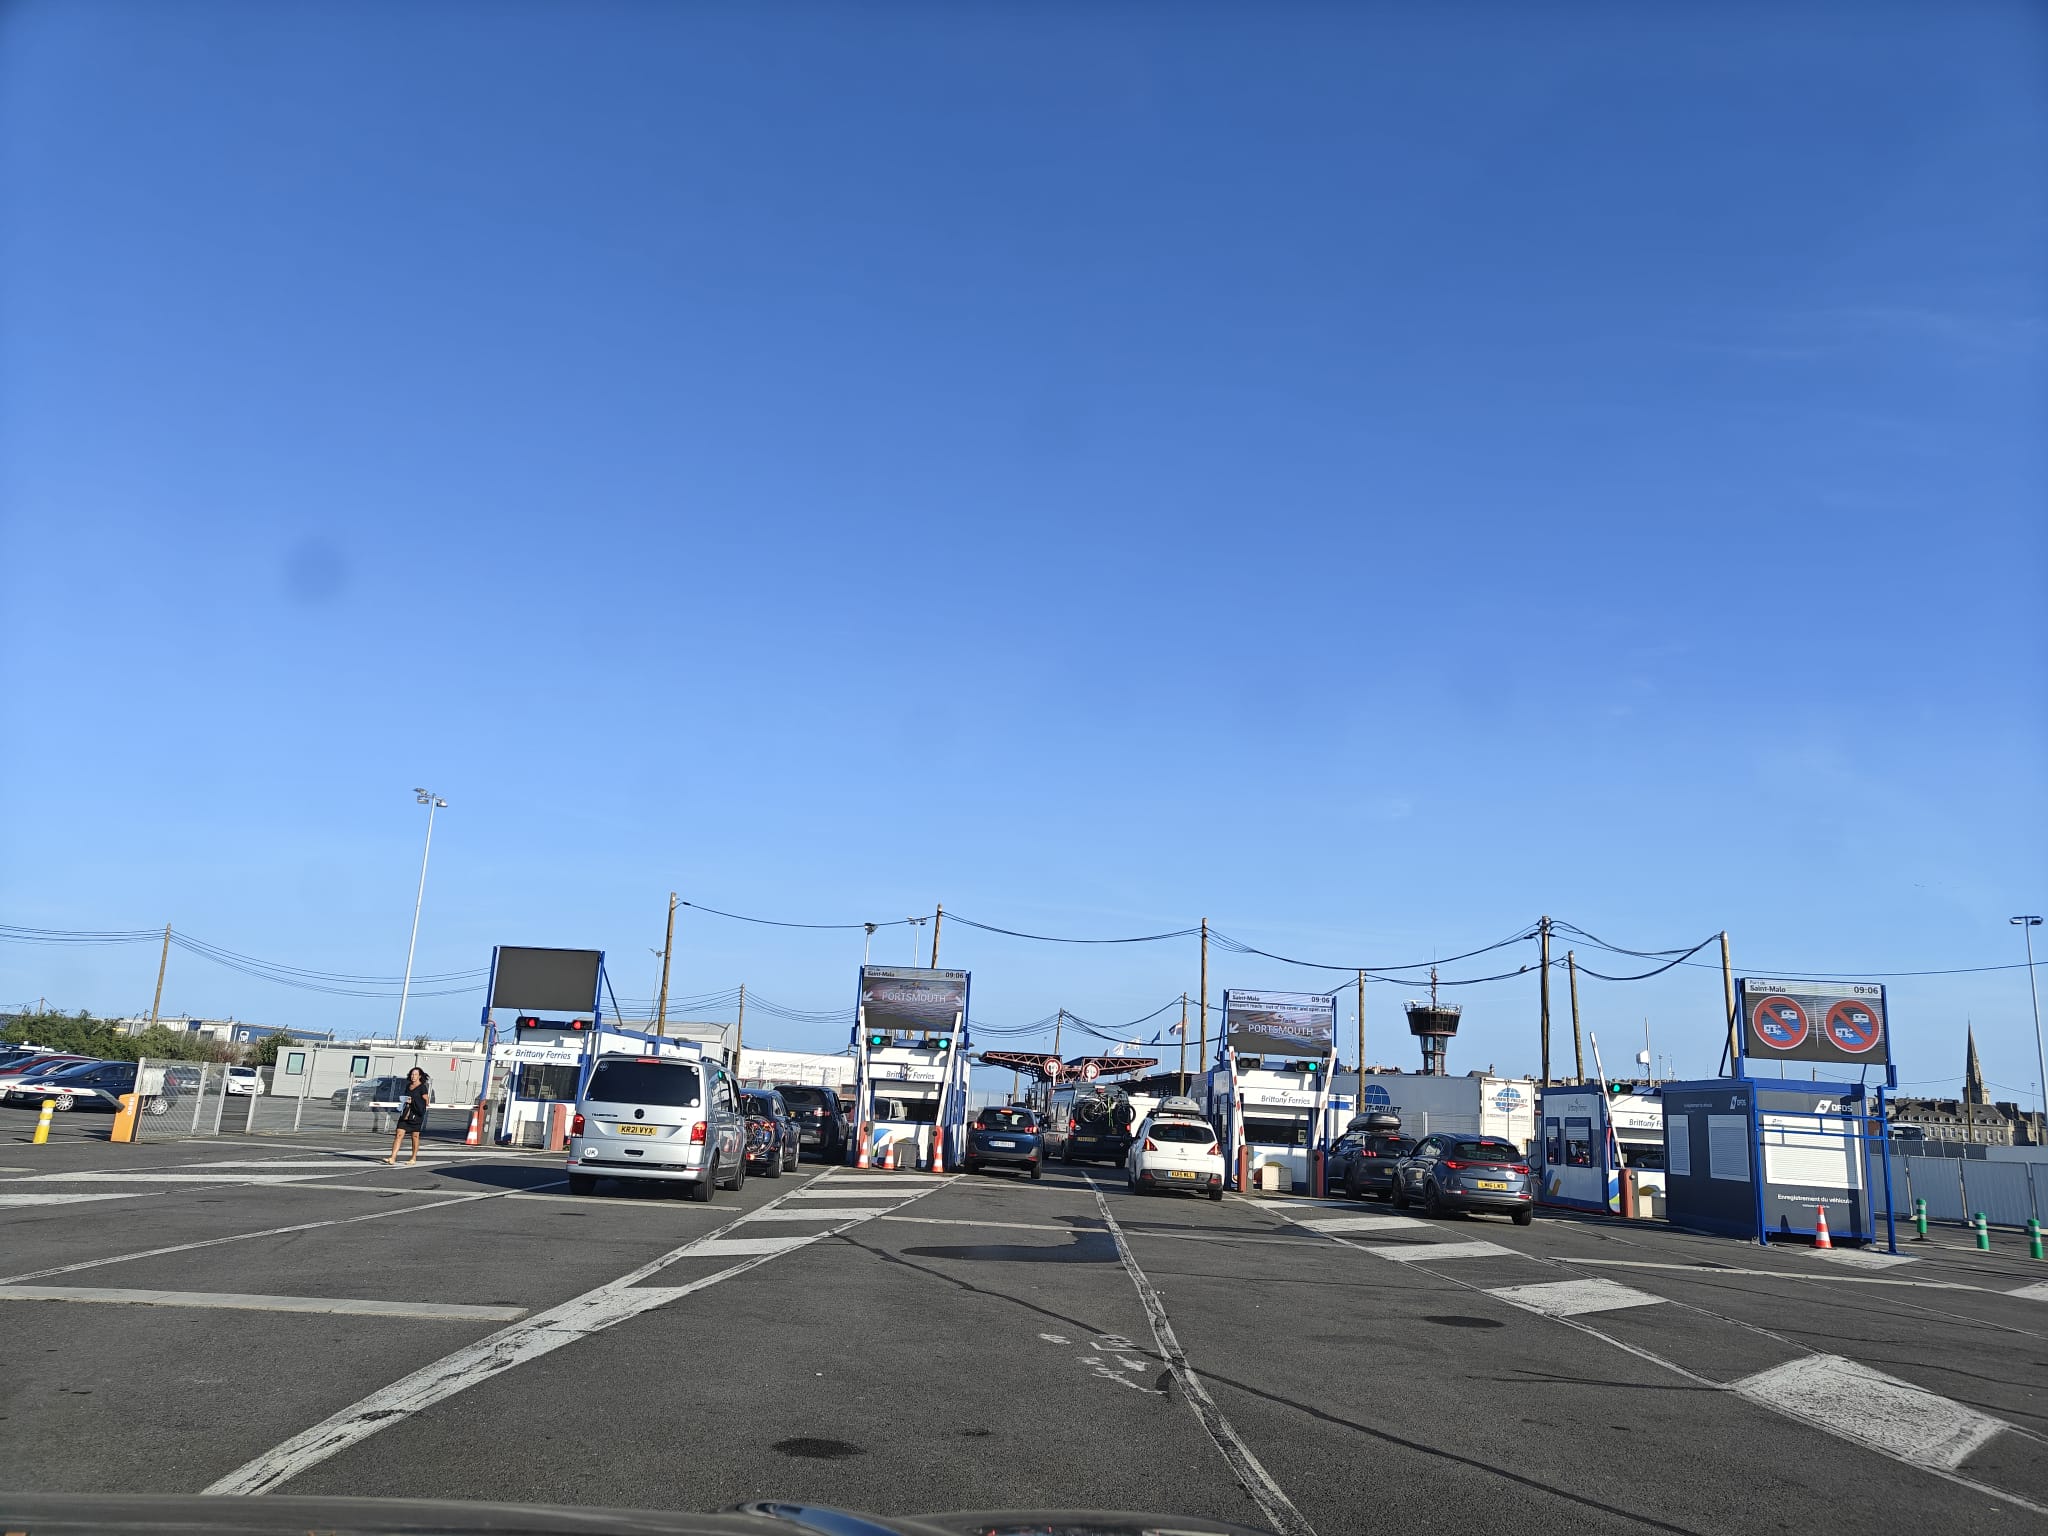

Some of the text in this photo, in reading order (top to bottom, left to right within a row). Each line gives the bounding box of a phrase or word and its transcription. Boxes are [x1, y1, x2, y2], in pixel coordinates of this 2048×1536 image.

[1750, 985, 1786, 993] Saint-Malo
[1853, 986, 1879, 995] 09:06
[882, 991, 946, 1003] PORTSMOUTH
[1232, 994, 1260, 1002] Saint-Malo
[1248, 1024, 1314, 1036] PORTSMOUTH
[515, 1049, 571, 1060] Brittany Ferries
[913, 1071, 935, 1080] Ferries
[1261, 1095, 1311, 1105] Brittany Ferries
[1831, 1104, 1853, 1112] DFDS
[1629, 1118, 1655, 1128] Brittany
[621, 1126, 654, 1135] KR21 VYX
